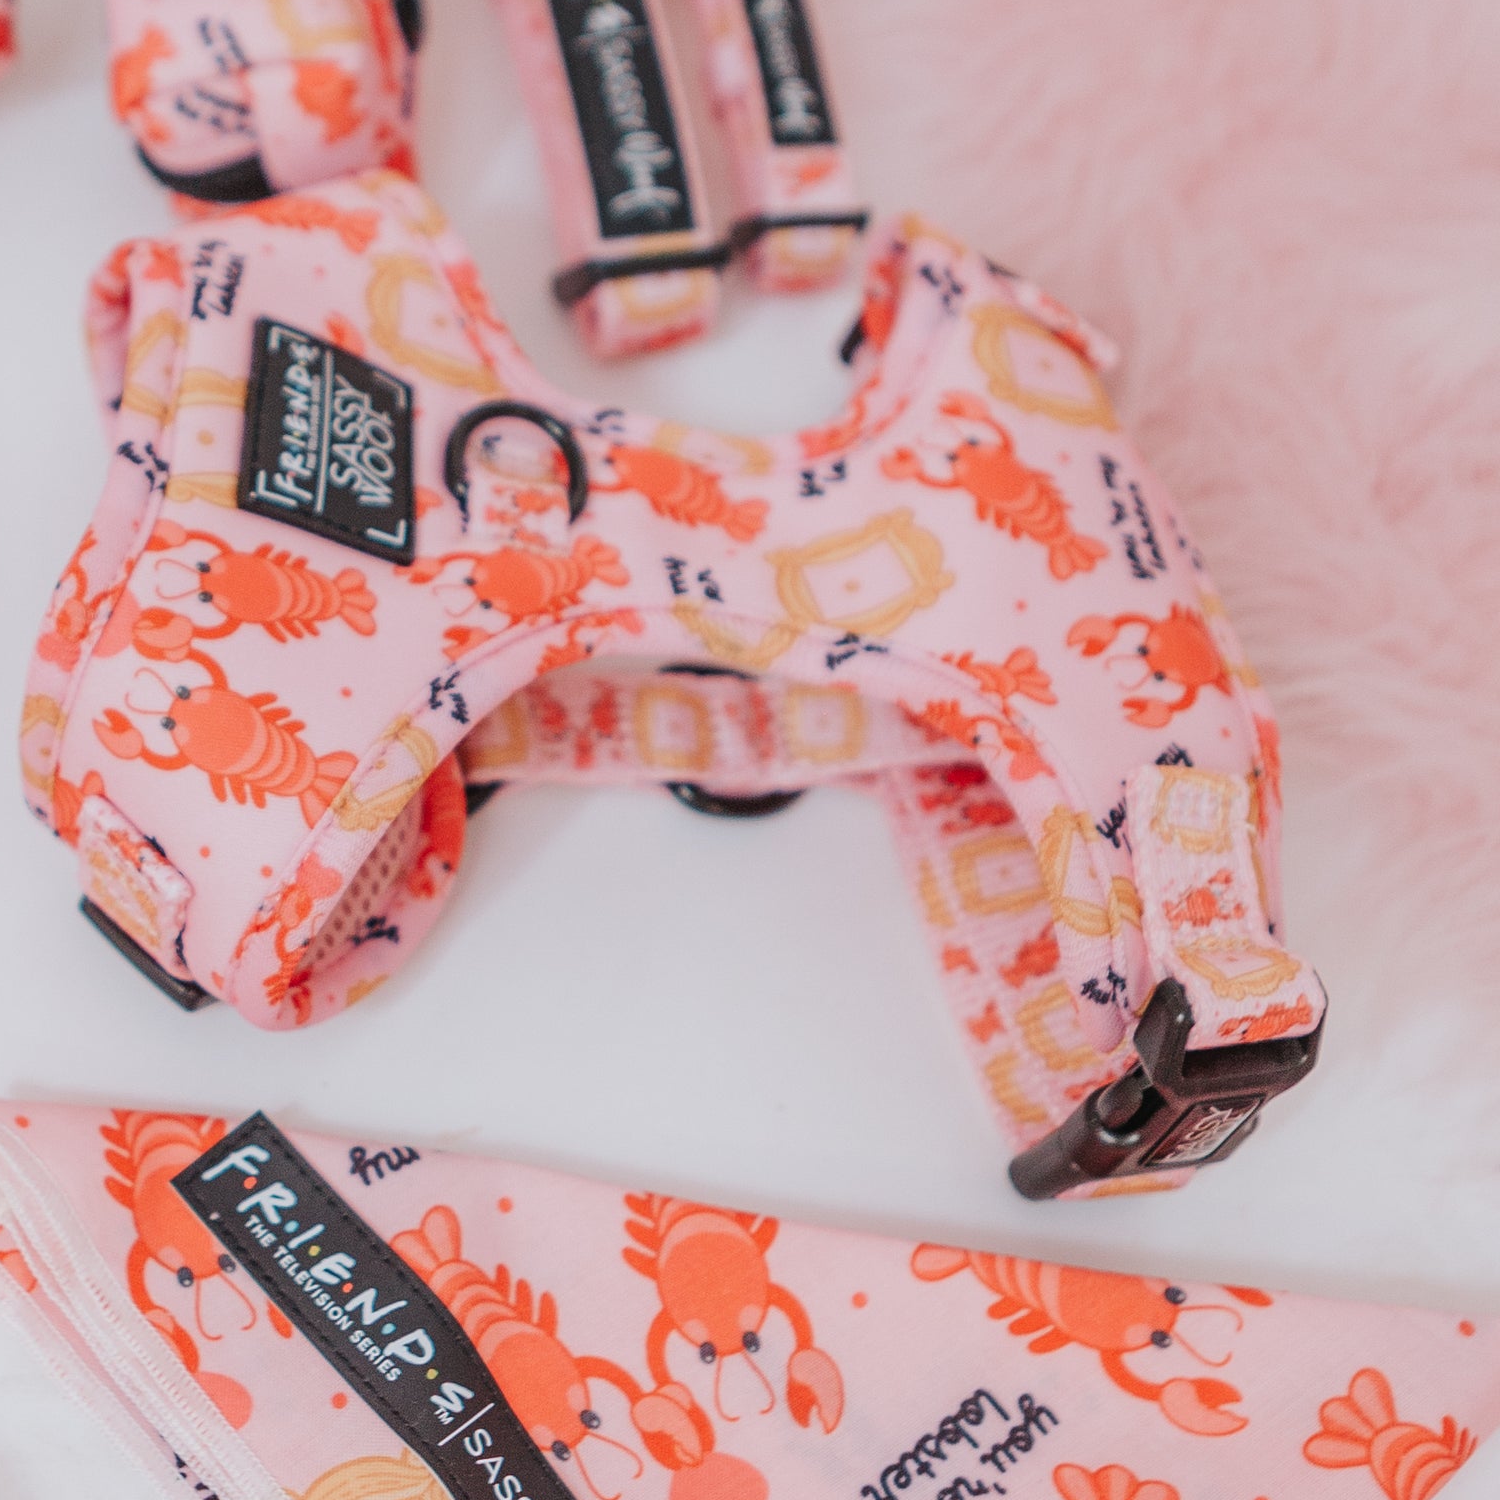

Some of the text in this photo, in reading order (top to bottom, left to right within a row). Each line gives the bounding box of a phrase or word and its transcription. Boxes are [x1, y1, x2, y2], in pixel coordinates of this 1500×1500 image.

[243, 1213, 403, 1383] THE TELEVISION SERIES
